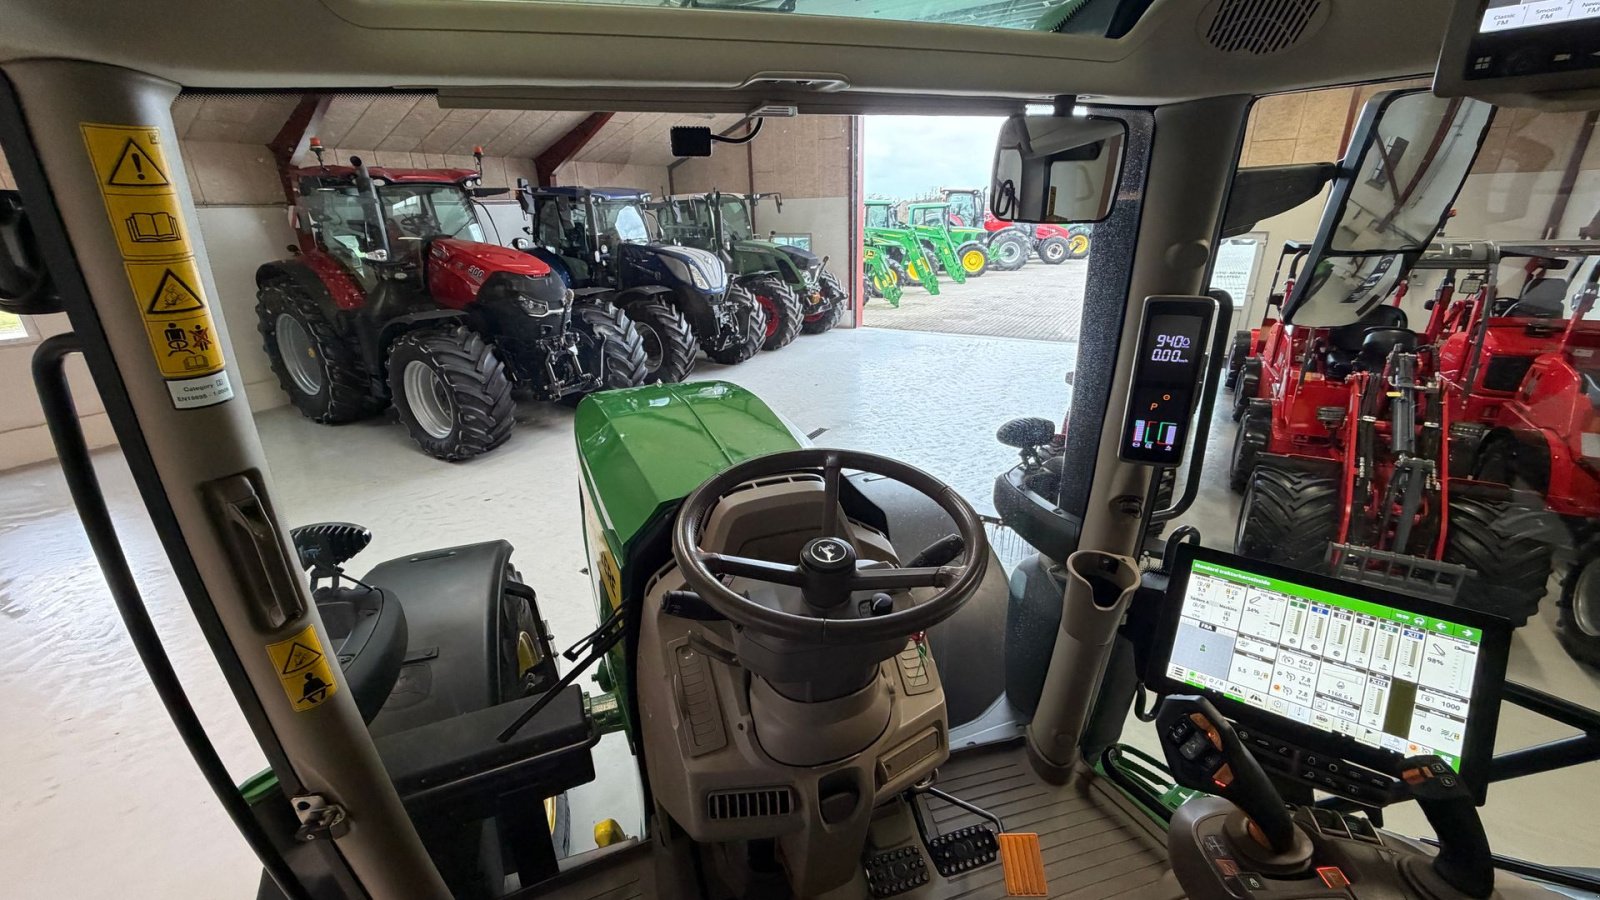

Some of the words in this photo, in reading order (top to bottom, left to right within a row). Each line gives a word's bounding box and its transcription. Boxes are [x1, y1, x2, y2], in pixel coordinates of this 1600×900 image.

[1536, 6, 1563, 14] Smooth
[1151, 348, 1181, 362] 0.00
[183, 384, 214, 392] Category
[1150, 402, 1158, 411] P
[1246, 606, 1260, 614] 34%
[1200, 622, 1212, 630] FRA
[1298, 658, 1313, 667] 42.0
[1427, 656, 1443, 666] 98%
[1300, 675, 1311, 683] 7.8
[1441, 700, 1460, 711] 1000
[1420, 724, 1431, 732] 0.0
